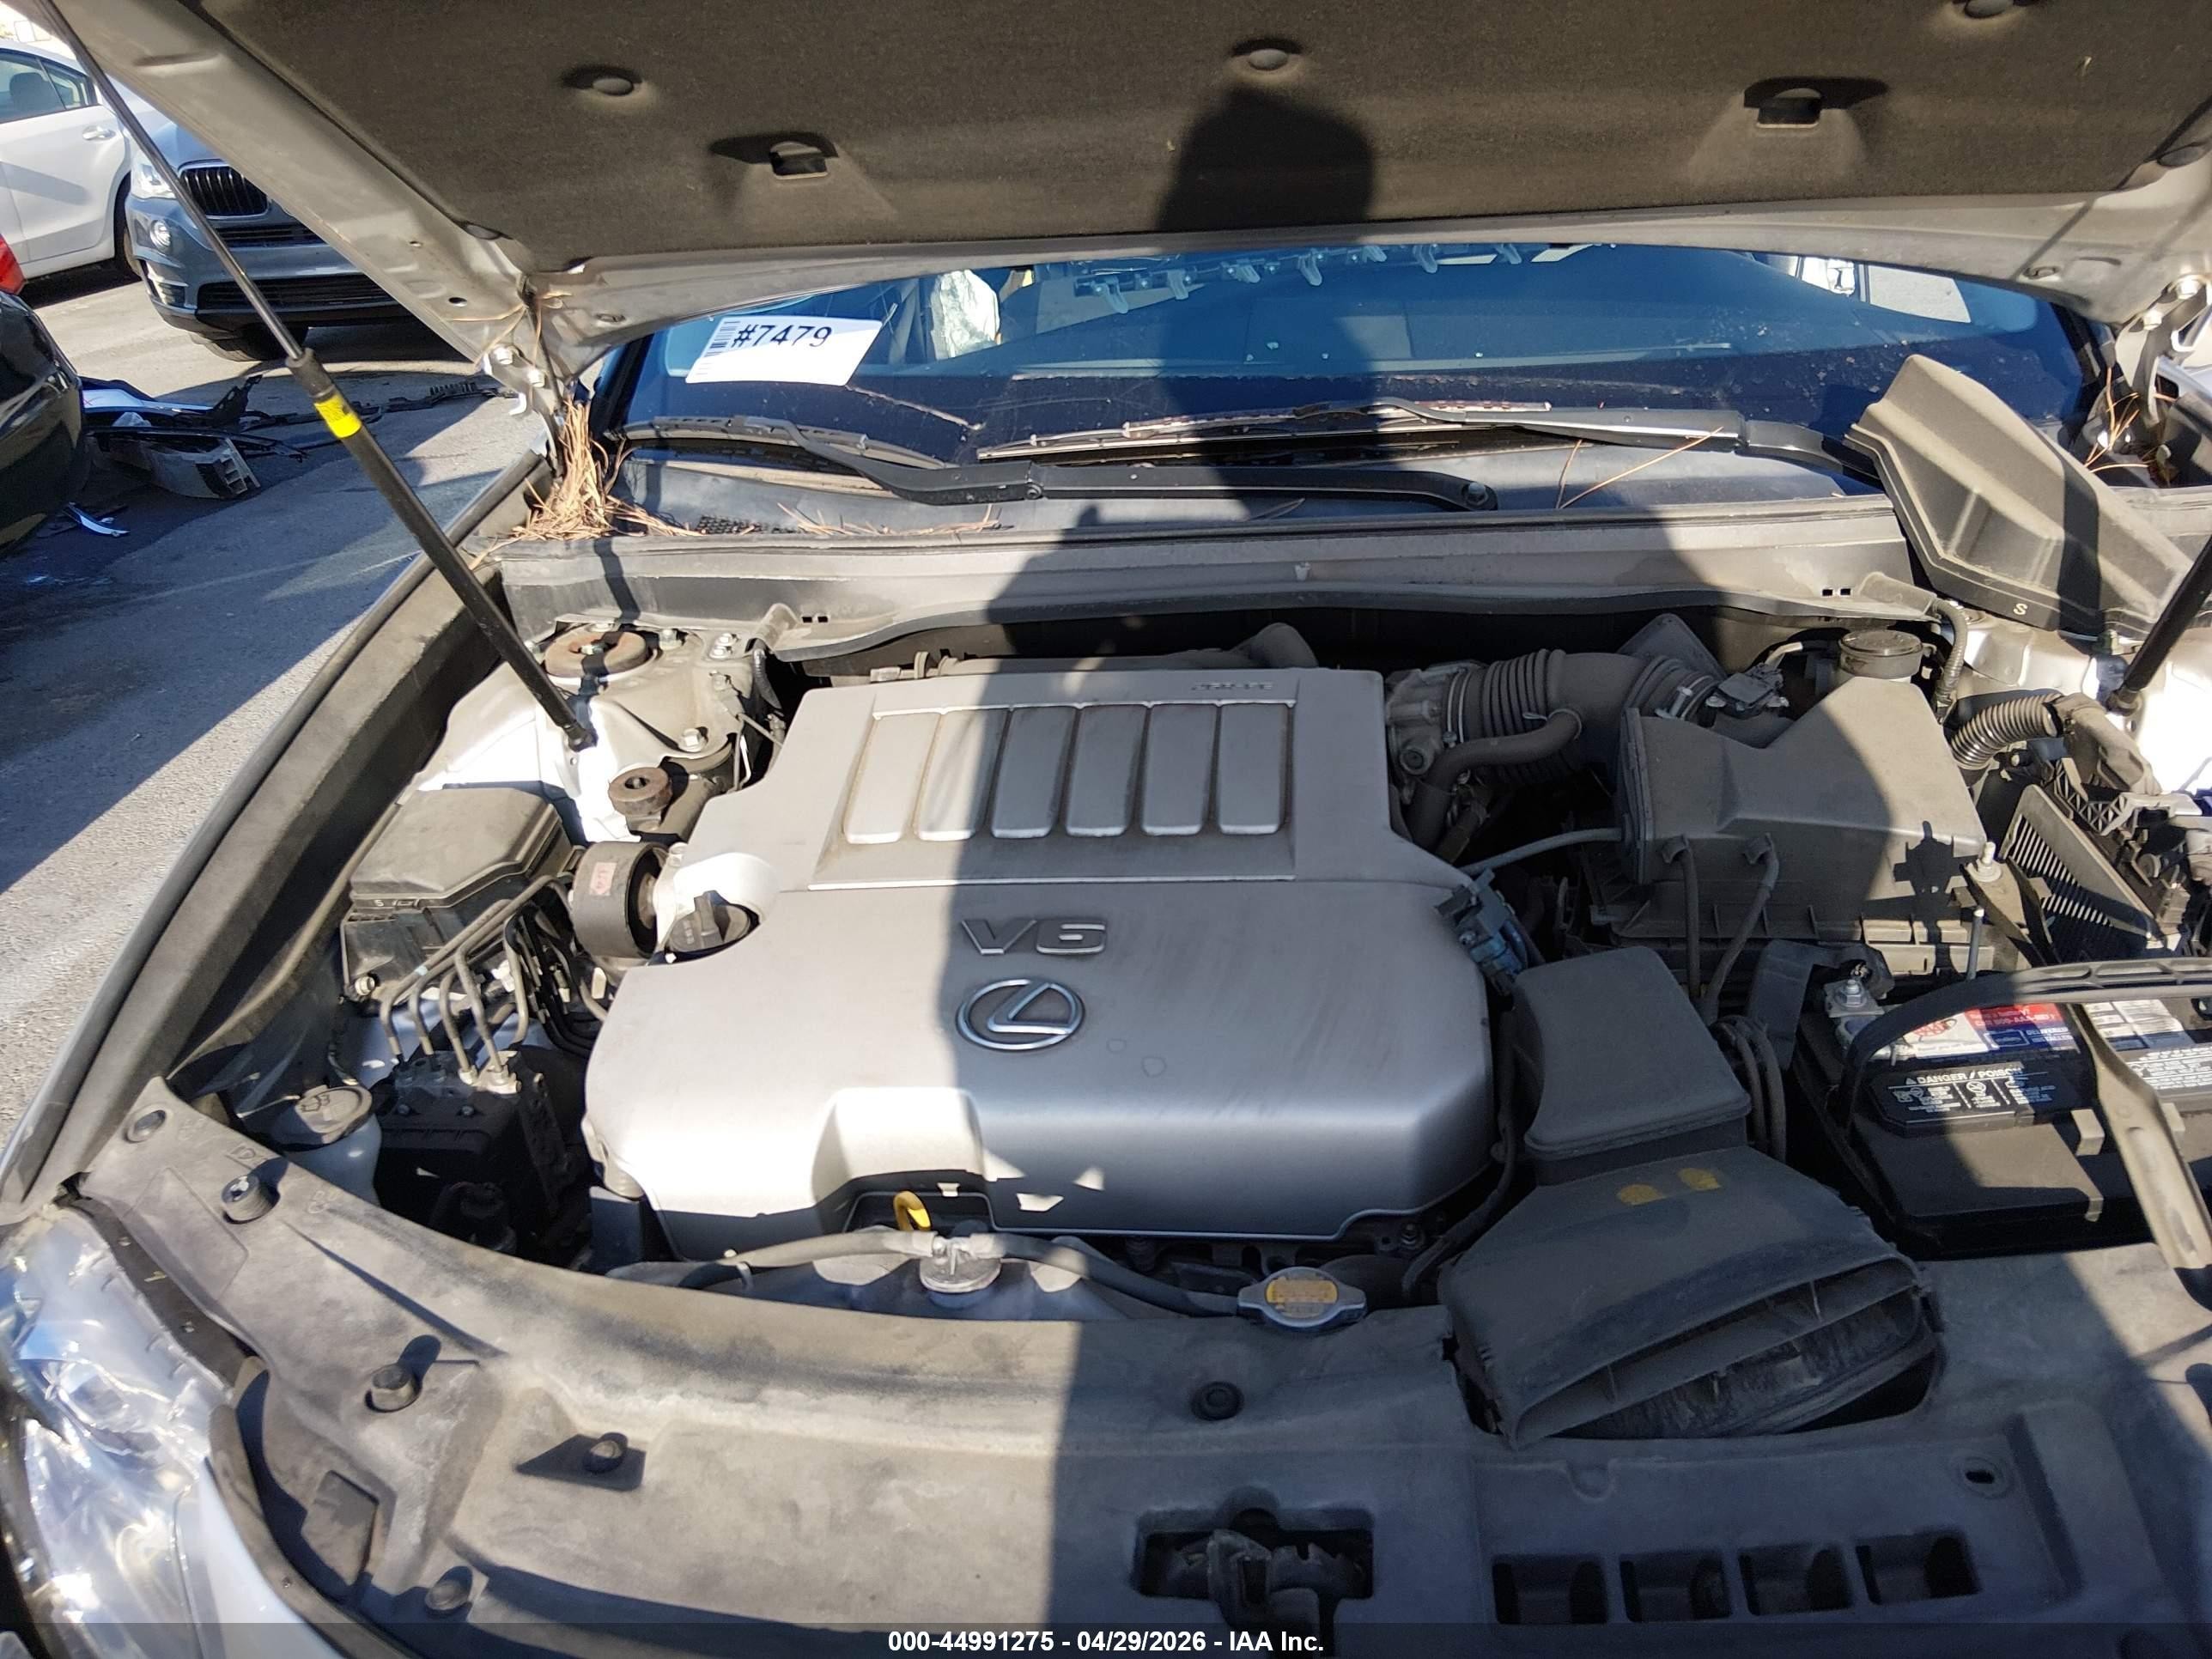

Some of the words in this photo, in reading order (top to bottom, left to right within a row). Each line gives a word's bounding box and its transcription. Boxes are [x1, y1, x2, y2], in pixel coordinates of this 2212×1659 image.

[731, 325, 832, 348] #7479
[2013, 603, 2028, 616] S
[961, 918, 1107, 957] V6
[1916, 1073, 1968, 1084] DANGER
